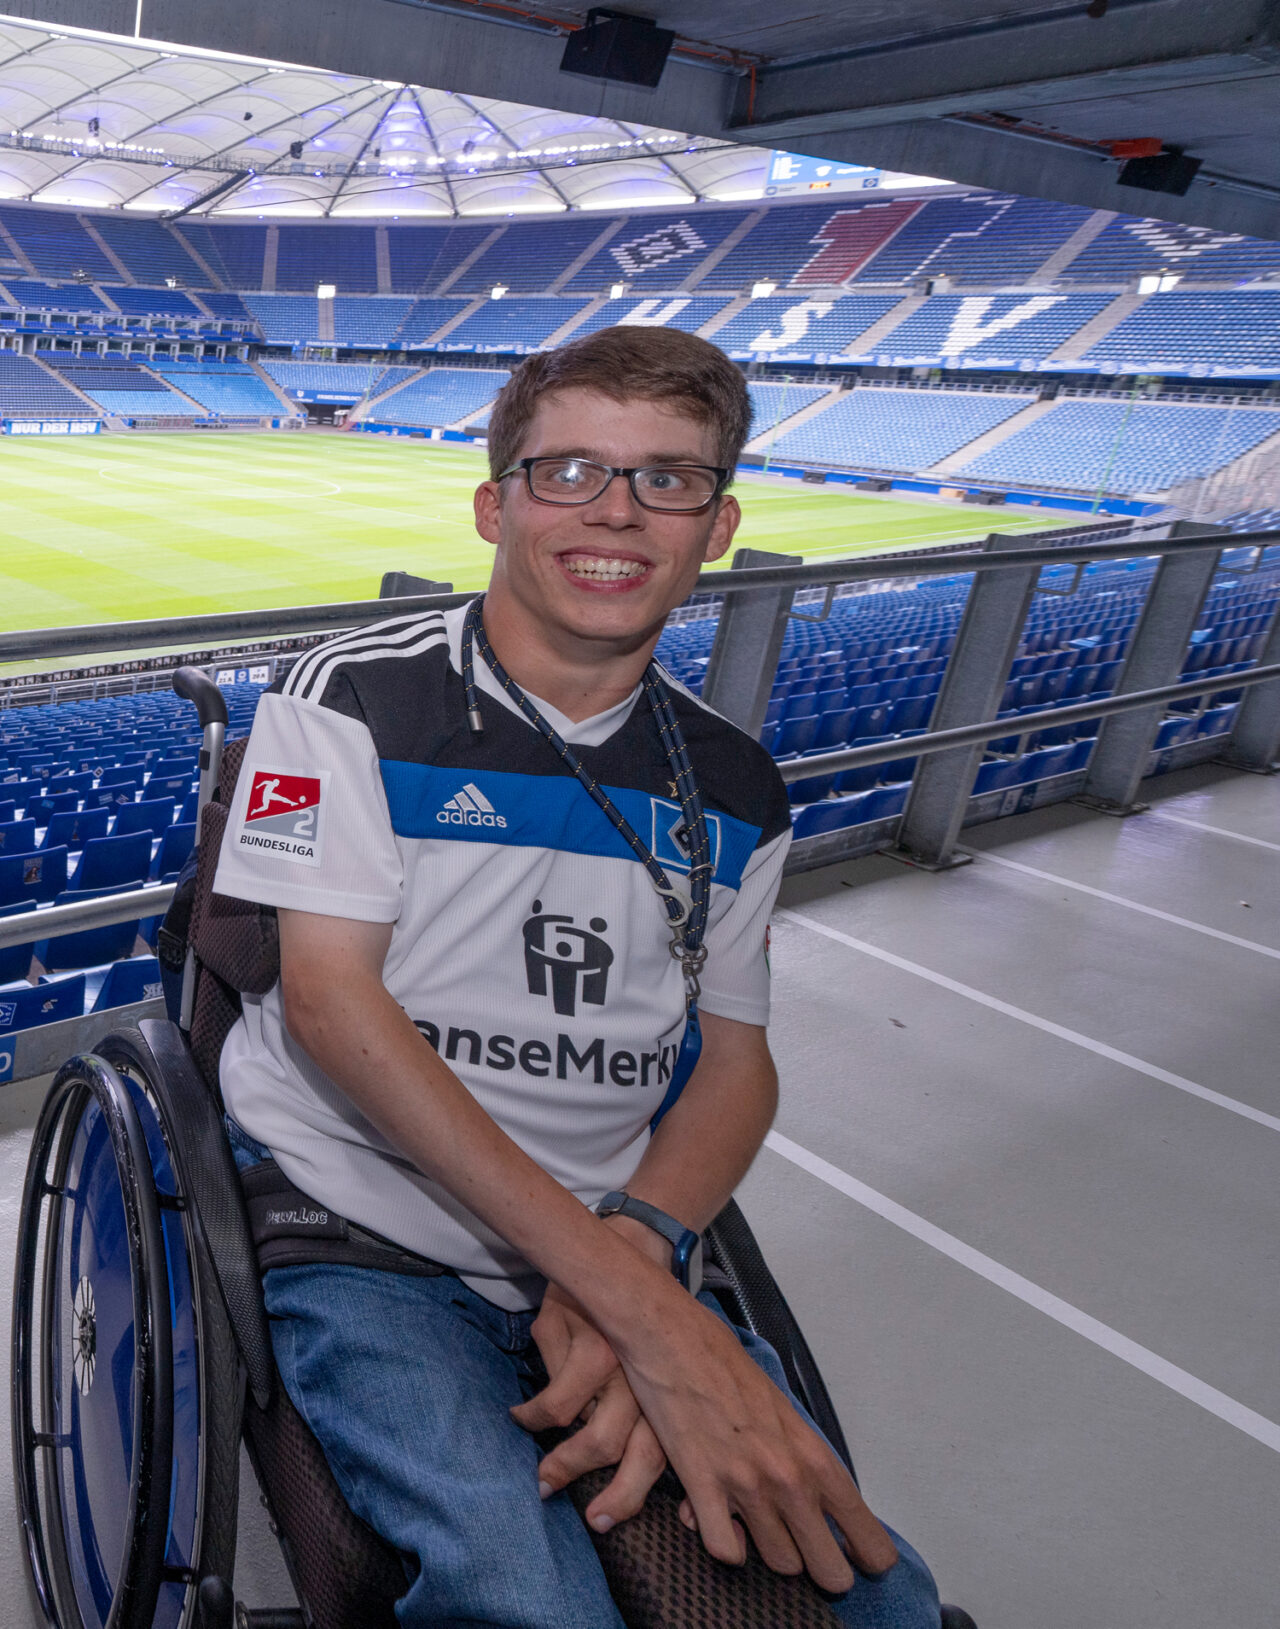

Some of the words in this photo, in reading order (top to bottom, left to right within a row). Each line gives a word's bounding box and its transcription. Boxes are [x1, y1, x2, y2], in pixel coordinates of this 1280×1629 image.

[11, 422, 41, 434] NUR
[42, 422, 69, 434] DER
[70, 422, 97, 434] HSV
[293, 809, 314, 836] 2
[436, 808, 507, 828] adidas
[240, 835, 314, 857] BUNDESLIGA
[412, 1020, 677, 1087] anseMerk
